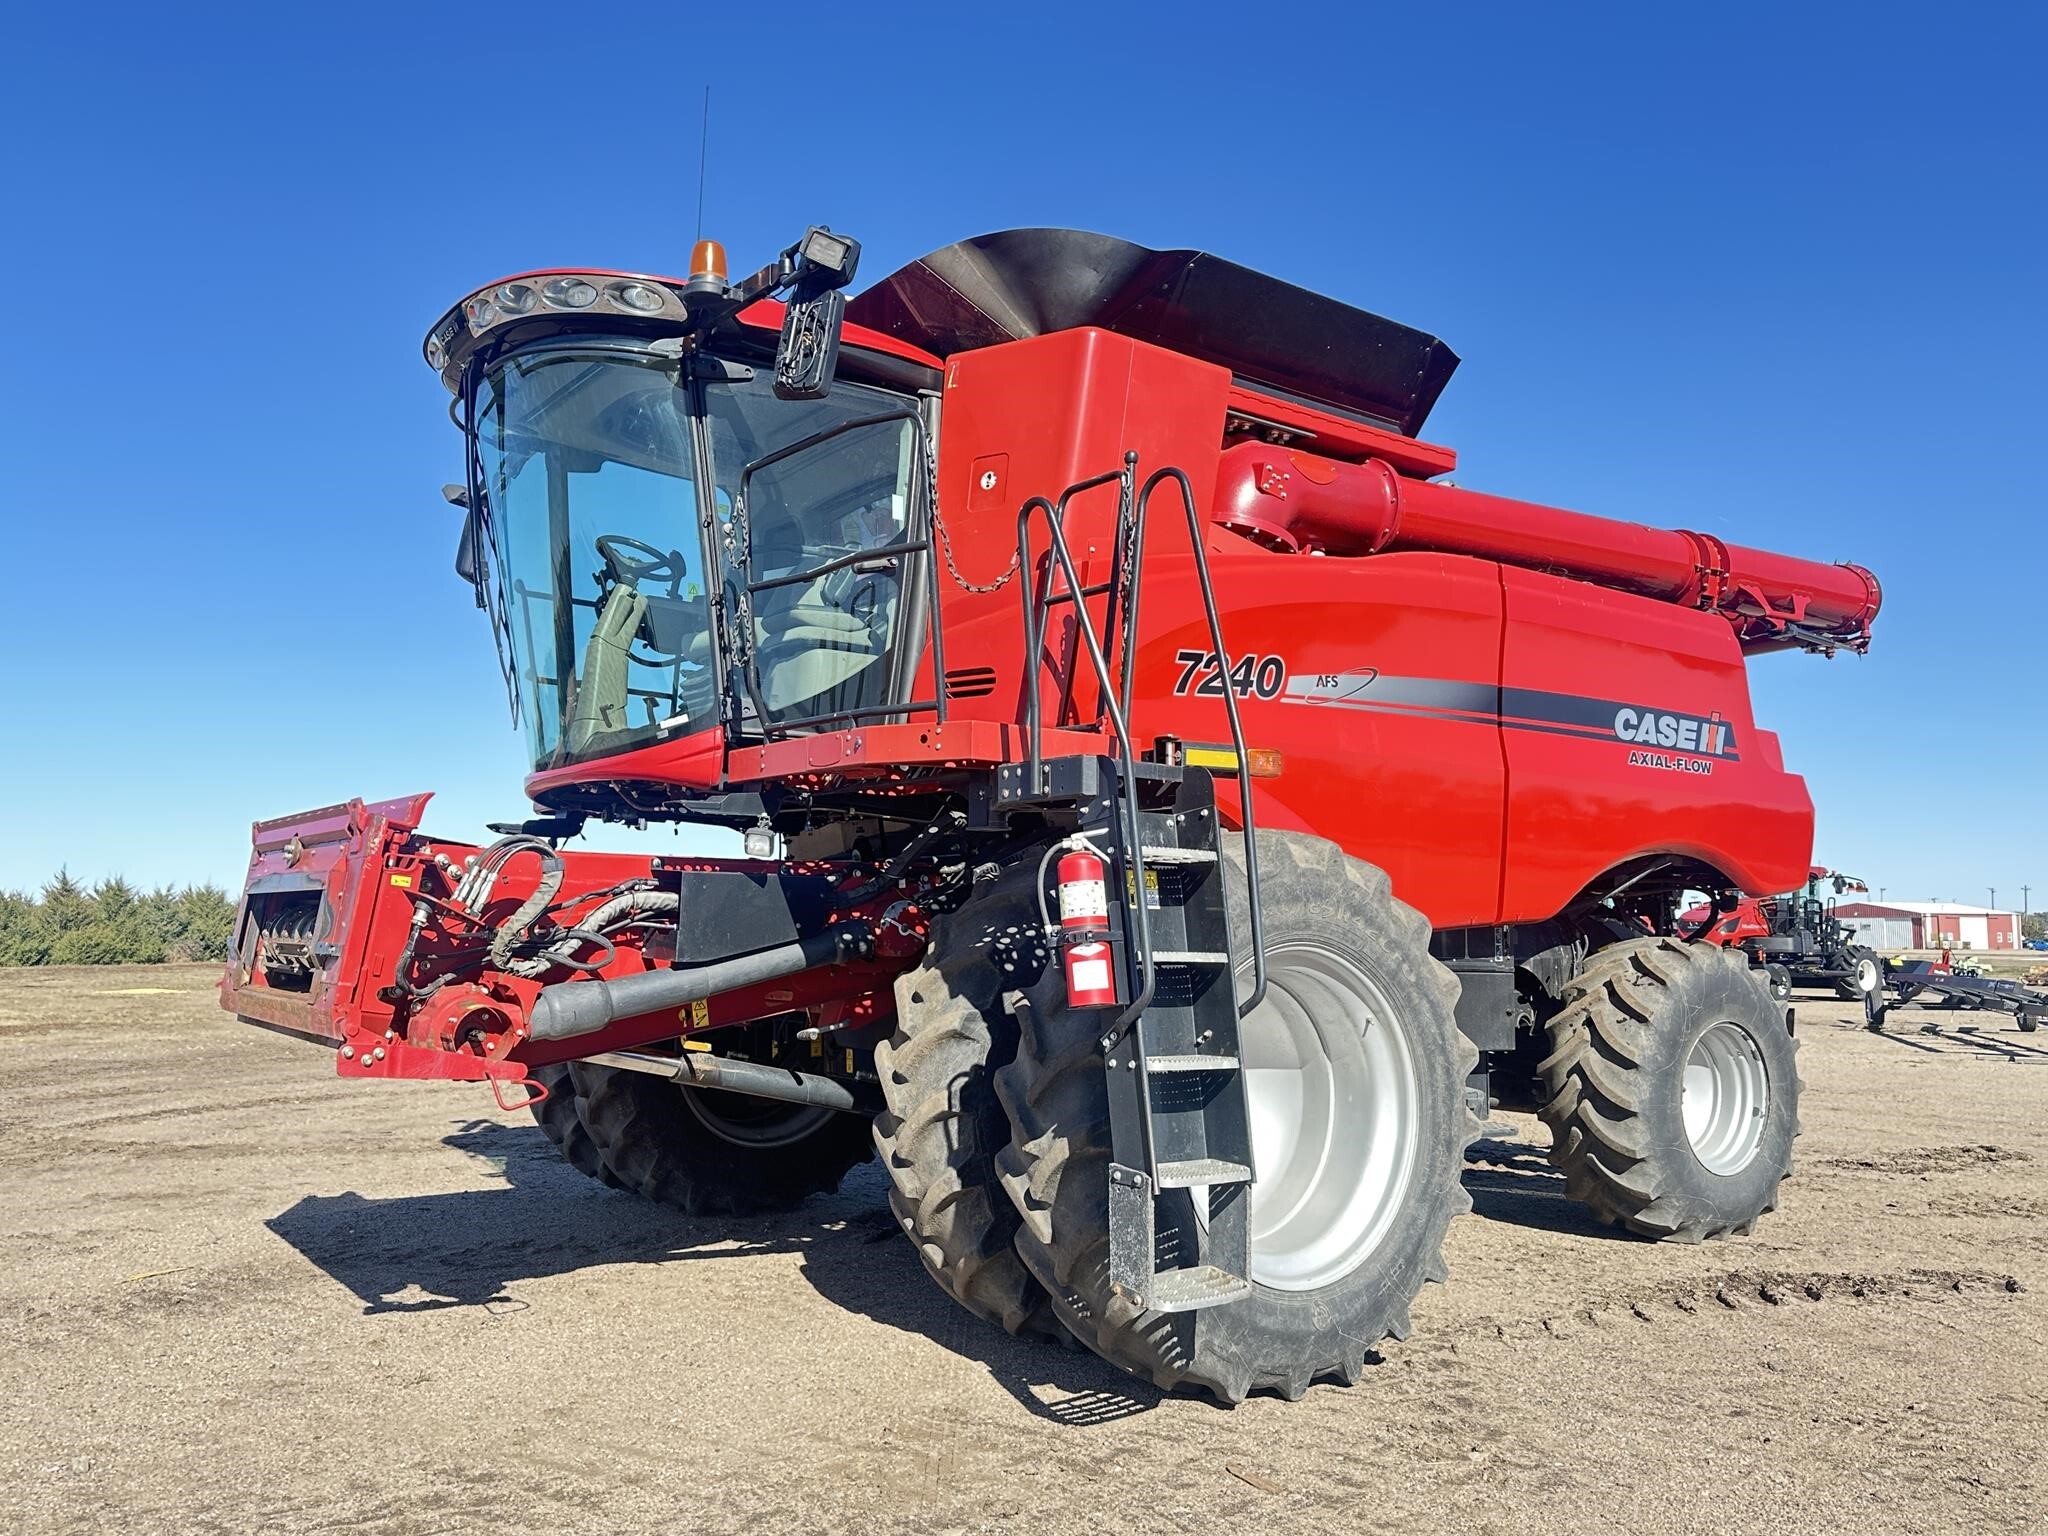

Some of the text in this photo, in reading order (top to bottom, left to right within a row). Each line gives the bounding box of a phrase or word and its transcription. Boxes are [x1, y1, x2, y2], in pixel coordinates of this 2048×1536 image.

[1173, 649, 1284, 700] 7240
[1316, 675, 1338, 688] AFS
[1614, 708, 1698, 751] CASE
[1628, 751, 1713, 775] AXIAL-FLOW
